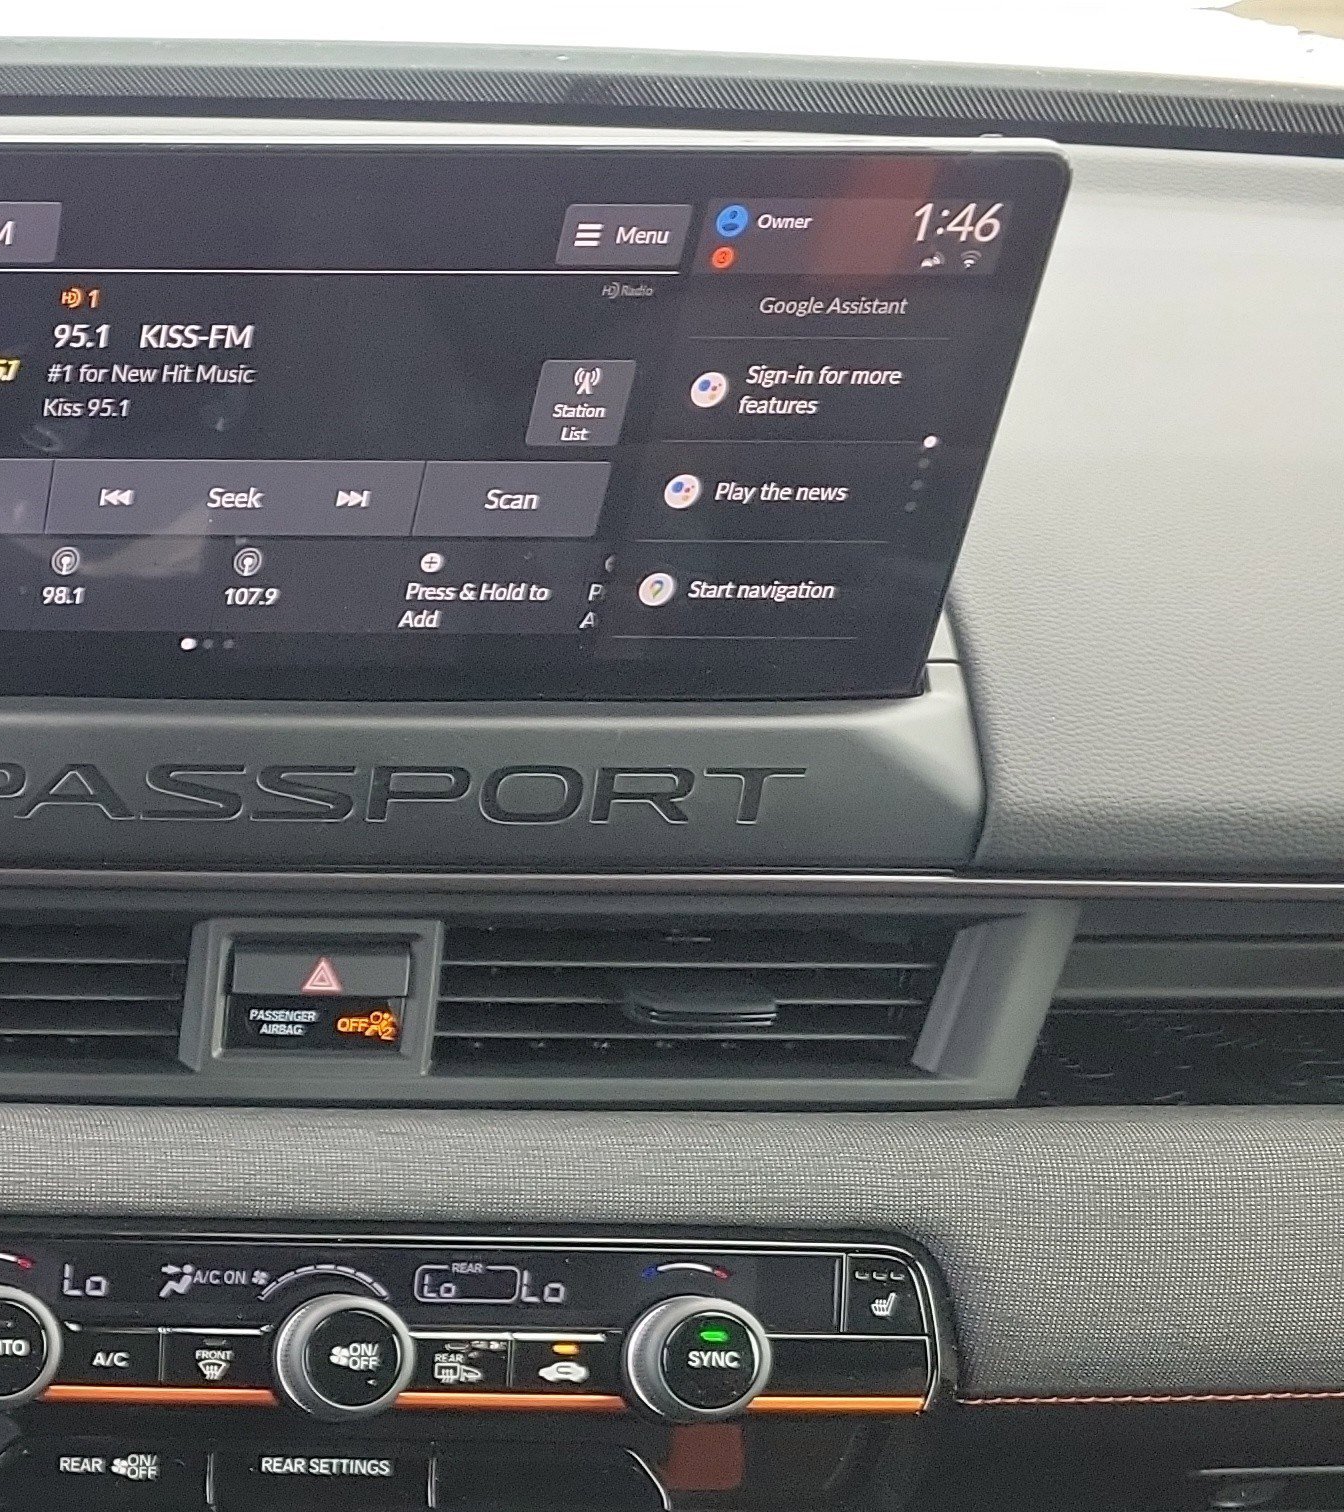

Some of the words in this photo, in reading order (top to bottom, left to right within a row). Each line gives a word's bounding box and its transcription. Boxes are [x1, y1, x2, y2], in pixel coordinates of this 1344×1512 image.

[757, 214, 811, 229] Owner
[912, 202, 1004, 243] 1:46
[615, 227, 669, 245] Menu
[89, 290, 100, 308] 1
[621, 285, 654, 297] Radio
[759, 297, 823, 317] Google
[827, 297, 908, 315] Assistant
[54, 324, 111, 348] 95.1
[139, 324, 255, 348] KISS-FM
[47, 364, 73, 383] #1
[79, 364, 108, 383] for
[111, 364, 157, 383] New
[162, 364, 194, 383] Hit
[196, 364, 257, 383] Music
[746, 365, 813, 388] Sign-in
[816, 365, 847, 385] for
[852, 369, 901, 385] more
[43, 398, 84, 417] Kiss
[87, 399, 131, 417] 95.1
[552, 404, 605, 419] Station
[738, 395, 818, 415] features
[560, 427, 590, 442] List
[208, 487, 263, 508] Seek
[484, 489, 537, 510] Scan
[715, 482, 756, 503] Play
[760, 482, 790, 500] the
[794, 485, 848, 501] news
[42, 586, 84, 605] 98.1
[225, 587, 279, 606] 107.9
[406, 583, 455, 601] Press
[459, 583, 476, 601] &
[480, 583, 521, 601] Hold
[526, 584, 550, 601] to
[688, 581, 730, 599] Start
[735, 581, 835, 602] navigation
[399, 611, 440, 628] Add
[249, 1009, 318, 1022] PASSENGER
[259, 1024, 306, 1036] AIRBAG
[337, 1018, 368, 1032] OFF
[193, 1270, 221, 1285] A/C
[225, 1270, 247, 1285] ON
[452, 1263, 483, 1274] REAR
[62, 1264, 108, 1297] Lo
[423, 1275, 456, 1299] Lo
[521, 1271, 565, 1303] Lo
[195, 1350, 232, 1362] FRONT
[350, 1343, 380, 1357] ON/
[434, 1353, 464, 1363] REAR
[688, 1350, 738, 1368] SYNC
[93, 1351, 129, 1368] A/C
[349, 1357, 379, 1371] OFF
[60, 1457, 105, 1474] REAR
[128, 1454, 158, 1468] ON/
[261, 1458, 306, 1474] REAR
[310, 1458, 390, 1475] SETTINGS
[127, 1467, 157, 1481] OFF
